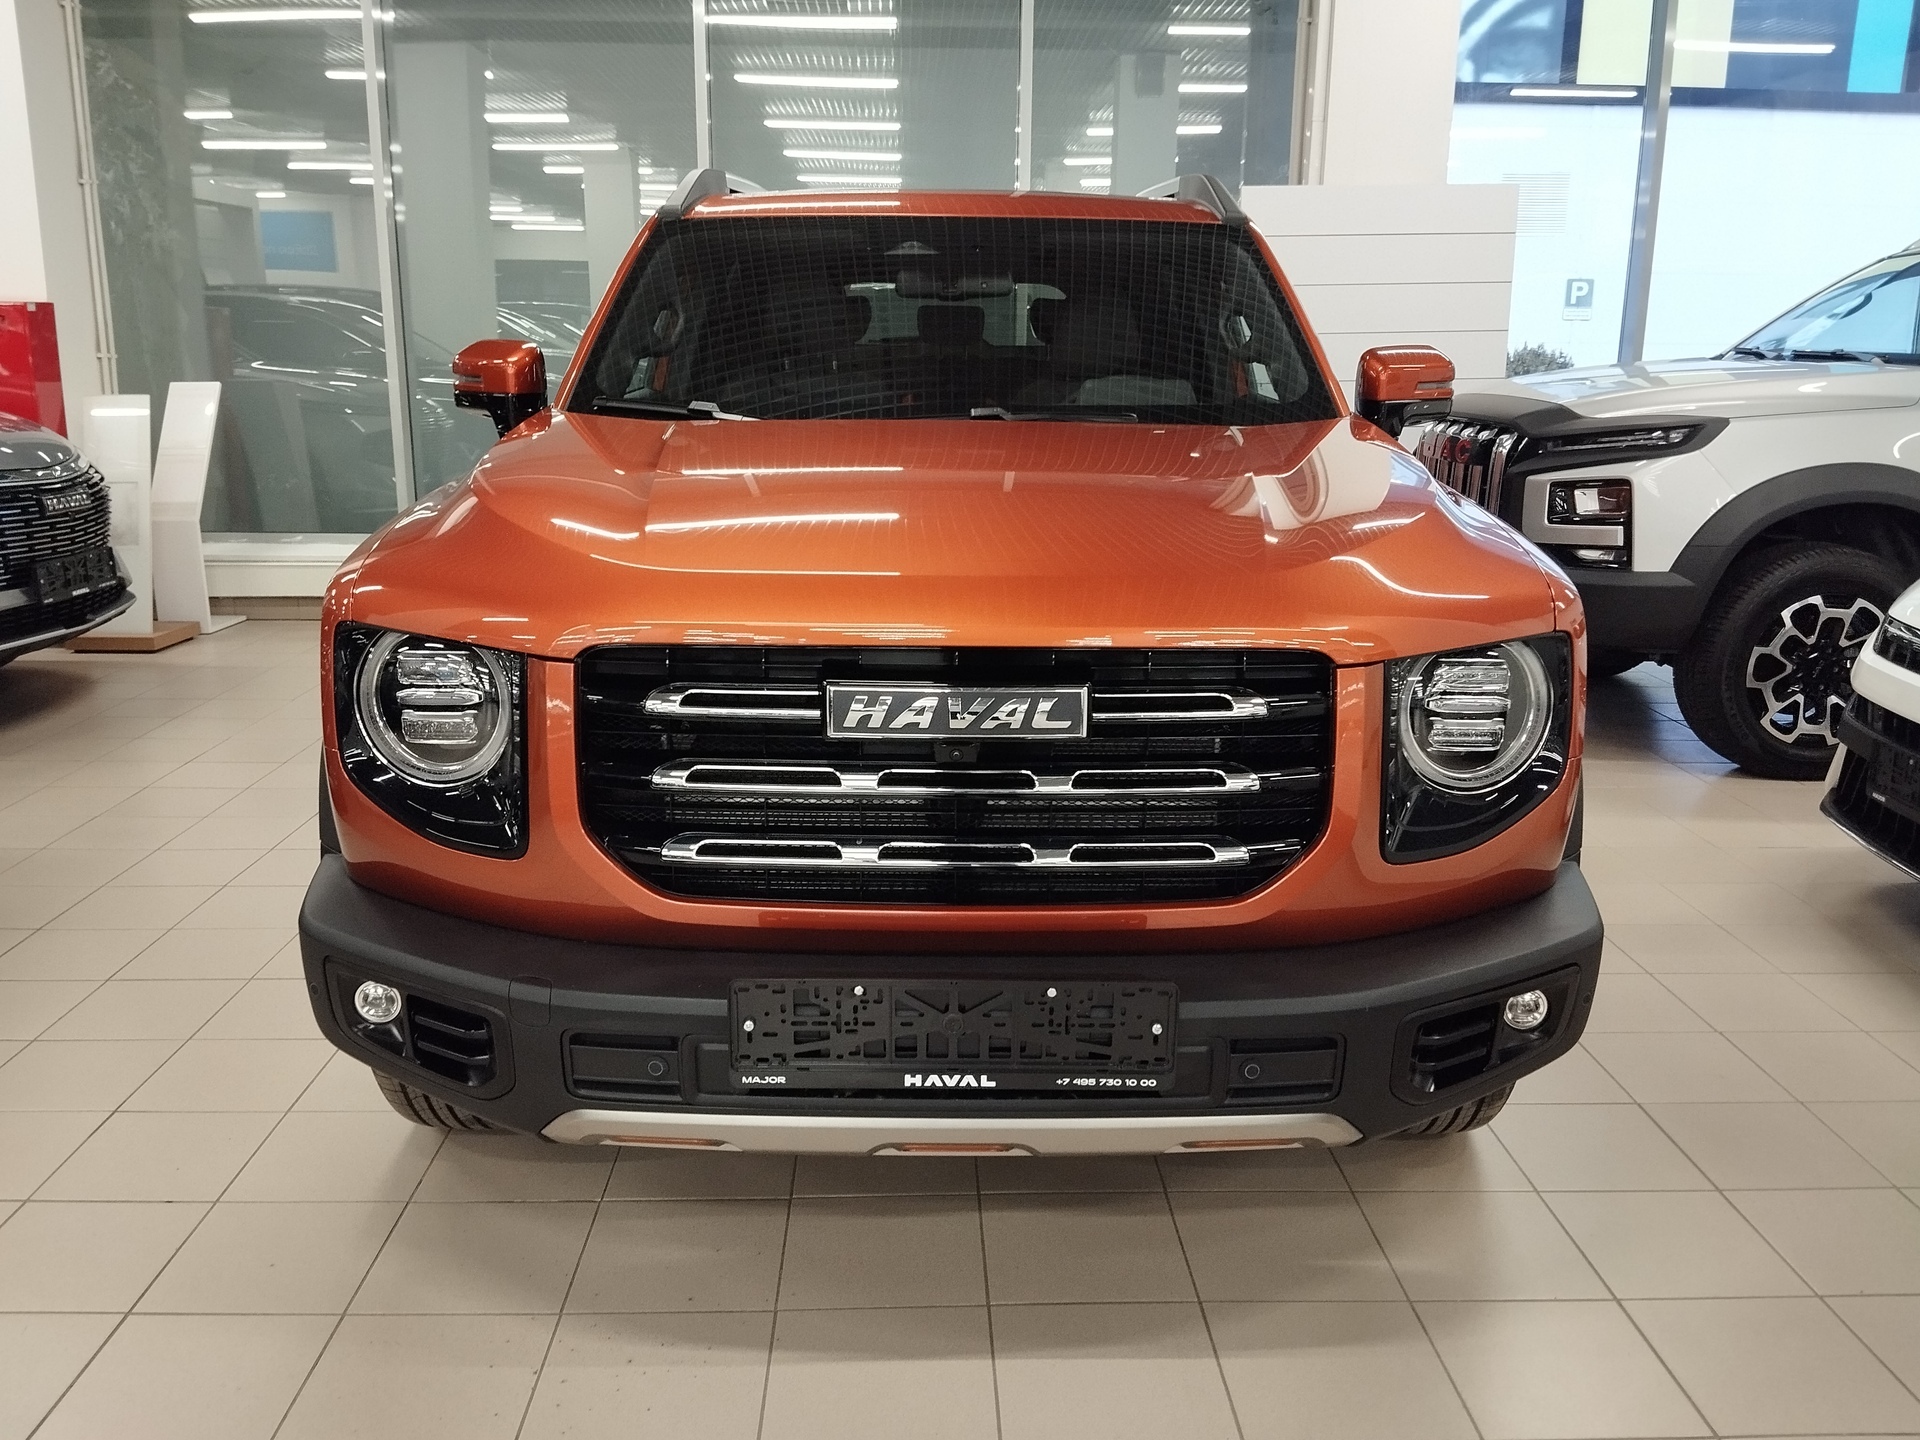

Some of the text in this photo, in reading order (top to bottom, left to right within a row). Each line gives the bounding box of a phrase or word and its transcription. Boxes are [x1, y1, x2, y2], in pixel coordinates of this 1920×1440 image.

[1570, 281, 1589, 305] P
[842, 695, 1072, 729] HAVAL
[741, 1075, 786, 1084] MAJOR
[904, 1074, 997, 1088] HAVAL
[1056, 1077, 1157, 1087] +7 495 730 10 00
